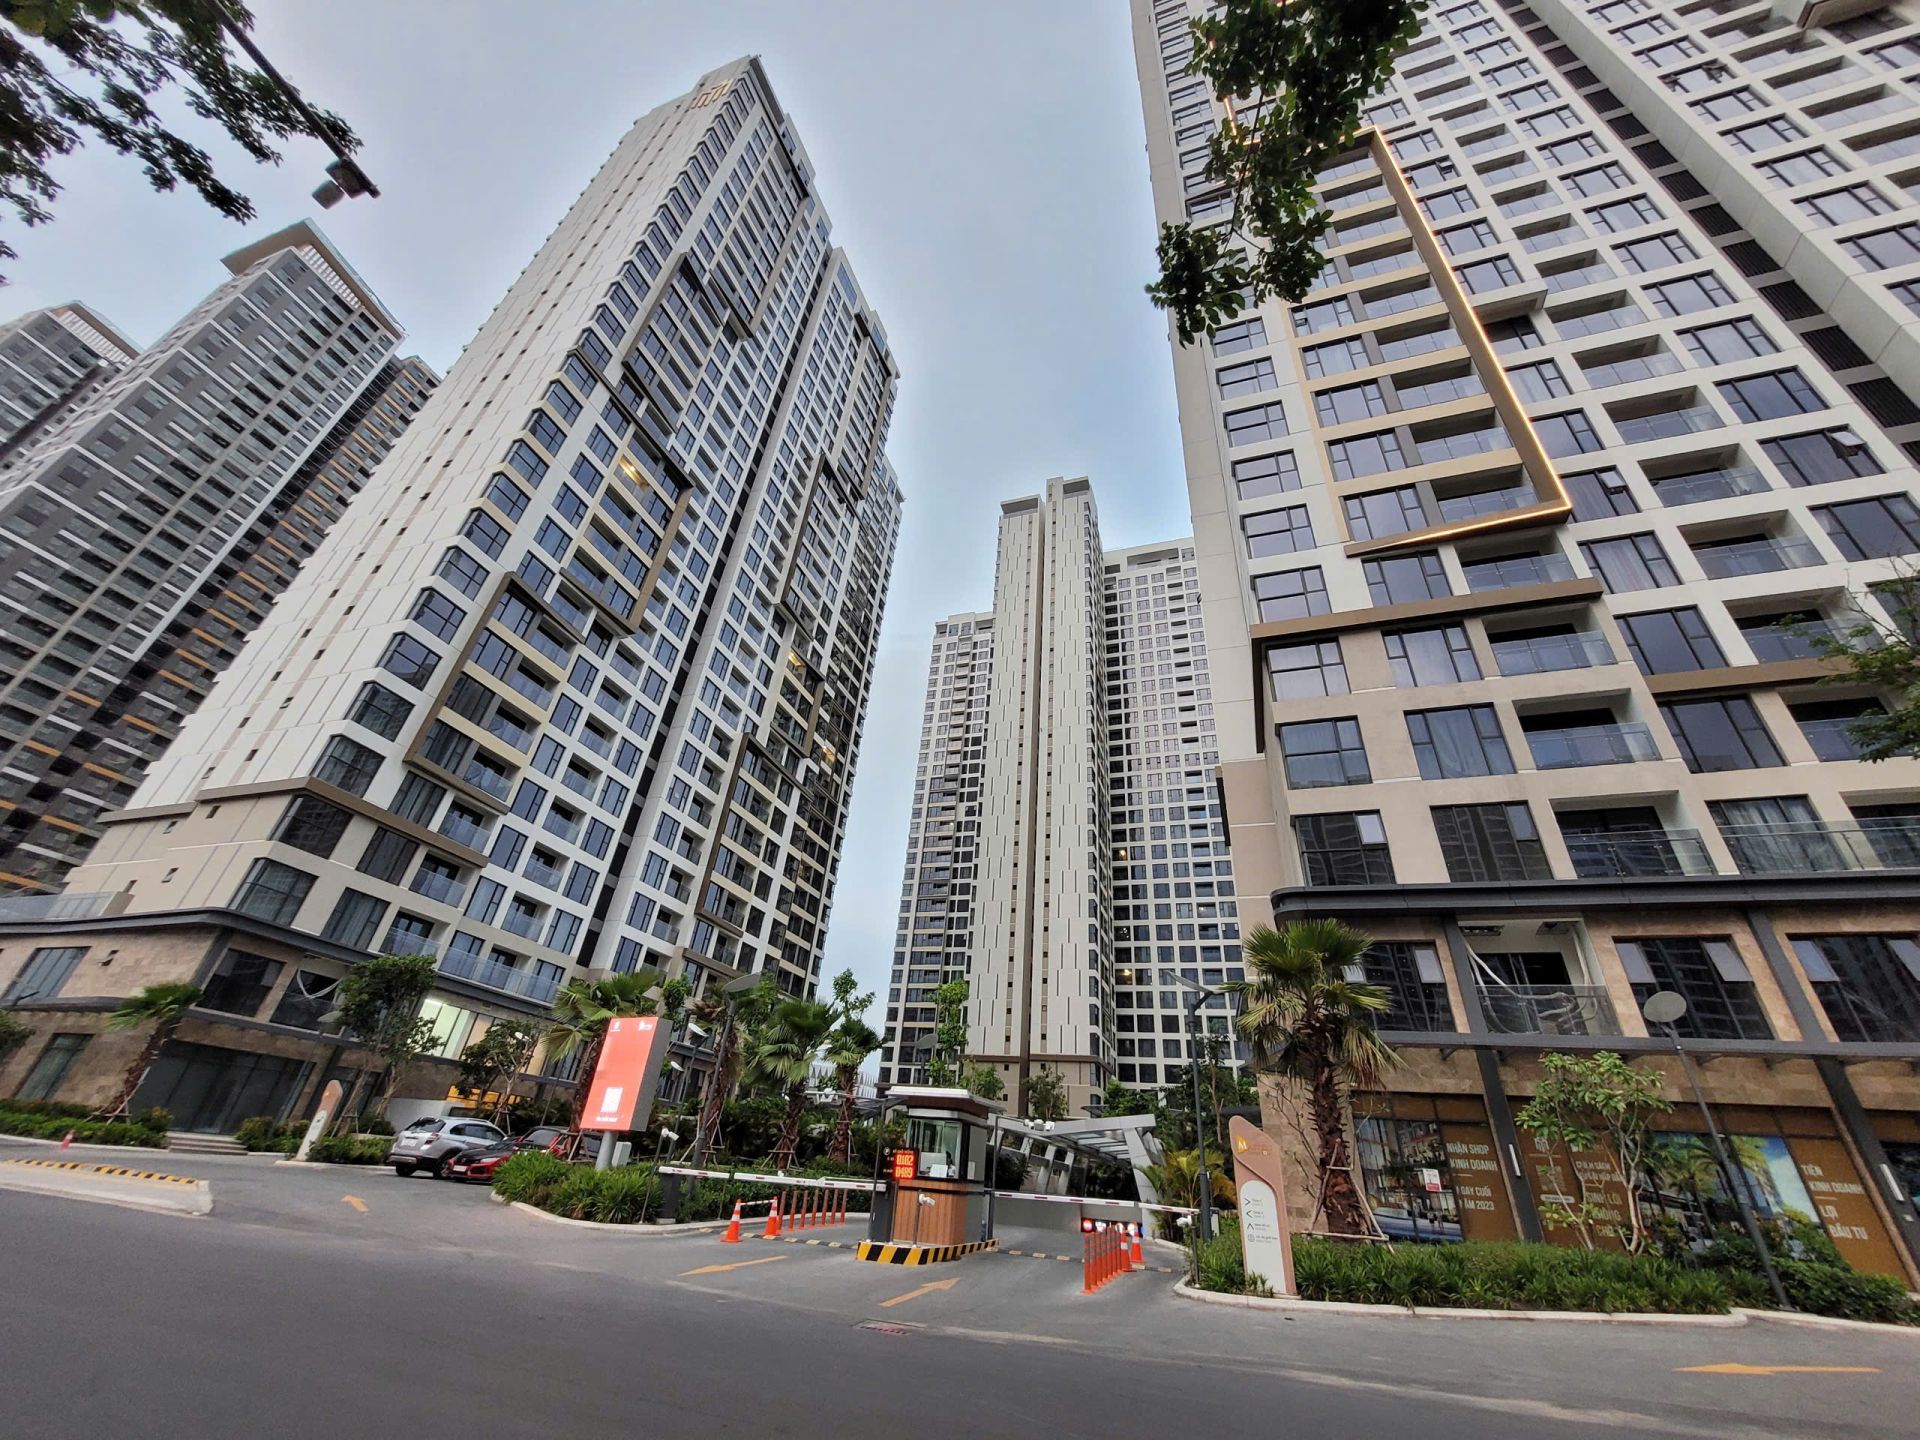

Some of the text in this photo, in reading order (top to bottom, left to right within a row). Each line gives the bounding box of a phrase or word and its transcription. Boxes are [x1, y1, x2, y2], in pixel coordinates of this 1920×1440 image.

[1469, 1143, 1489, 1154] SHOP
[1450, 1158, 1498, 1171] KINH DOANH
[1476, 1200, 1495, 1210] 2023
